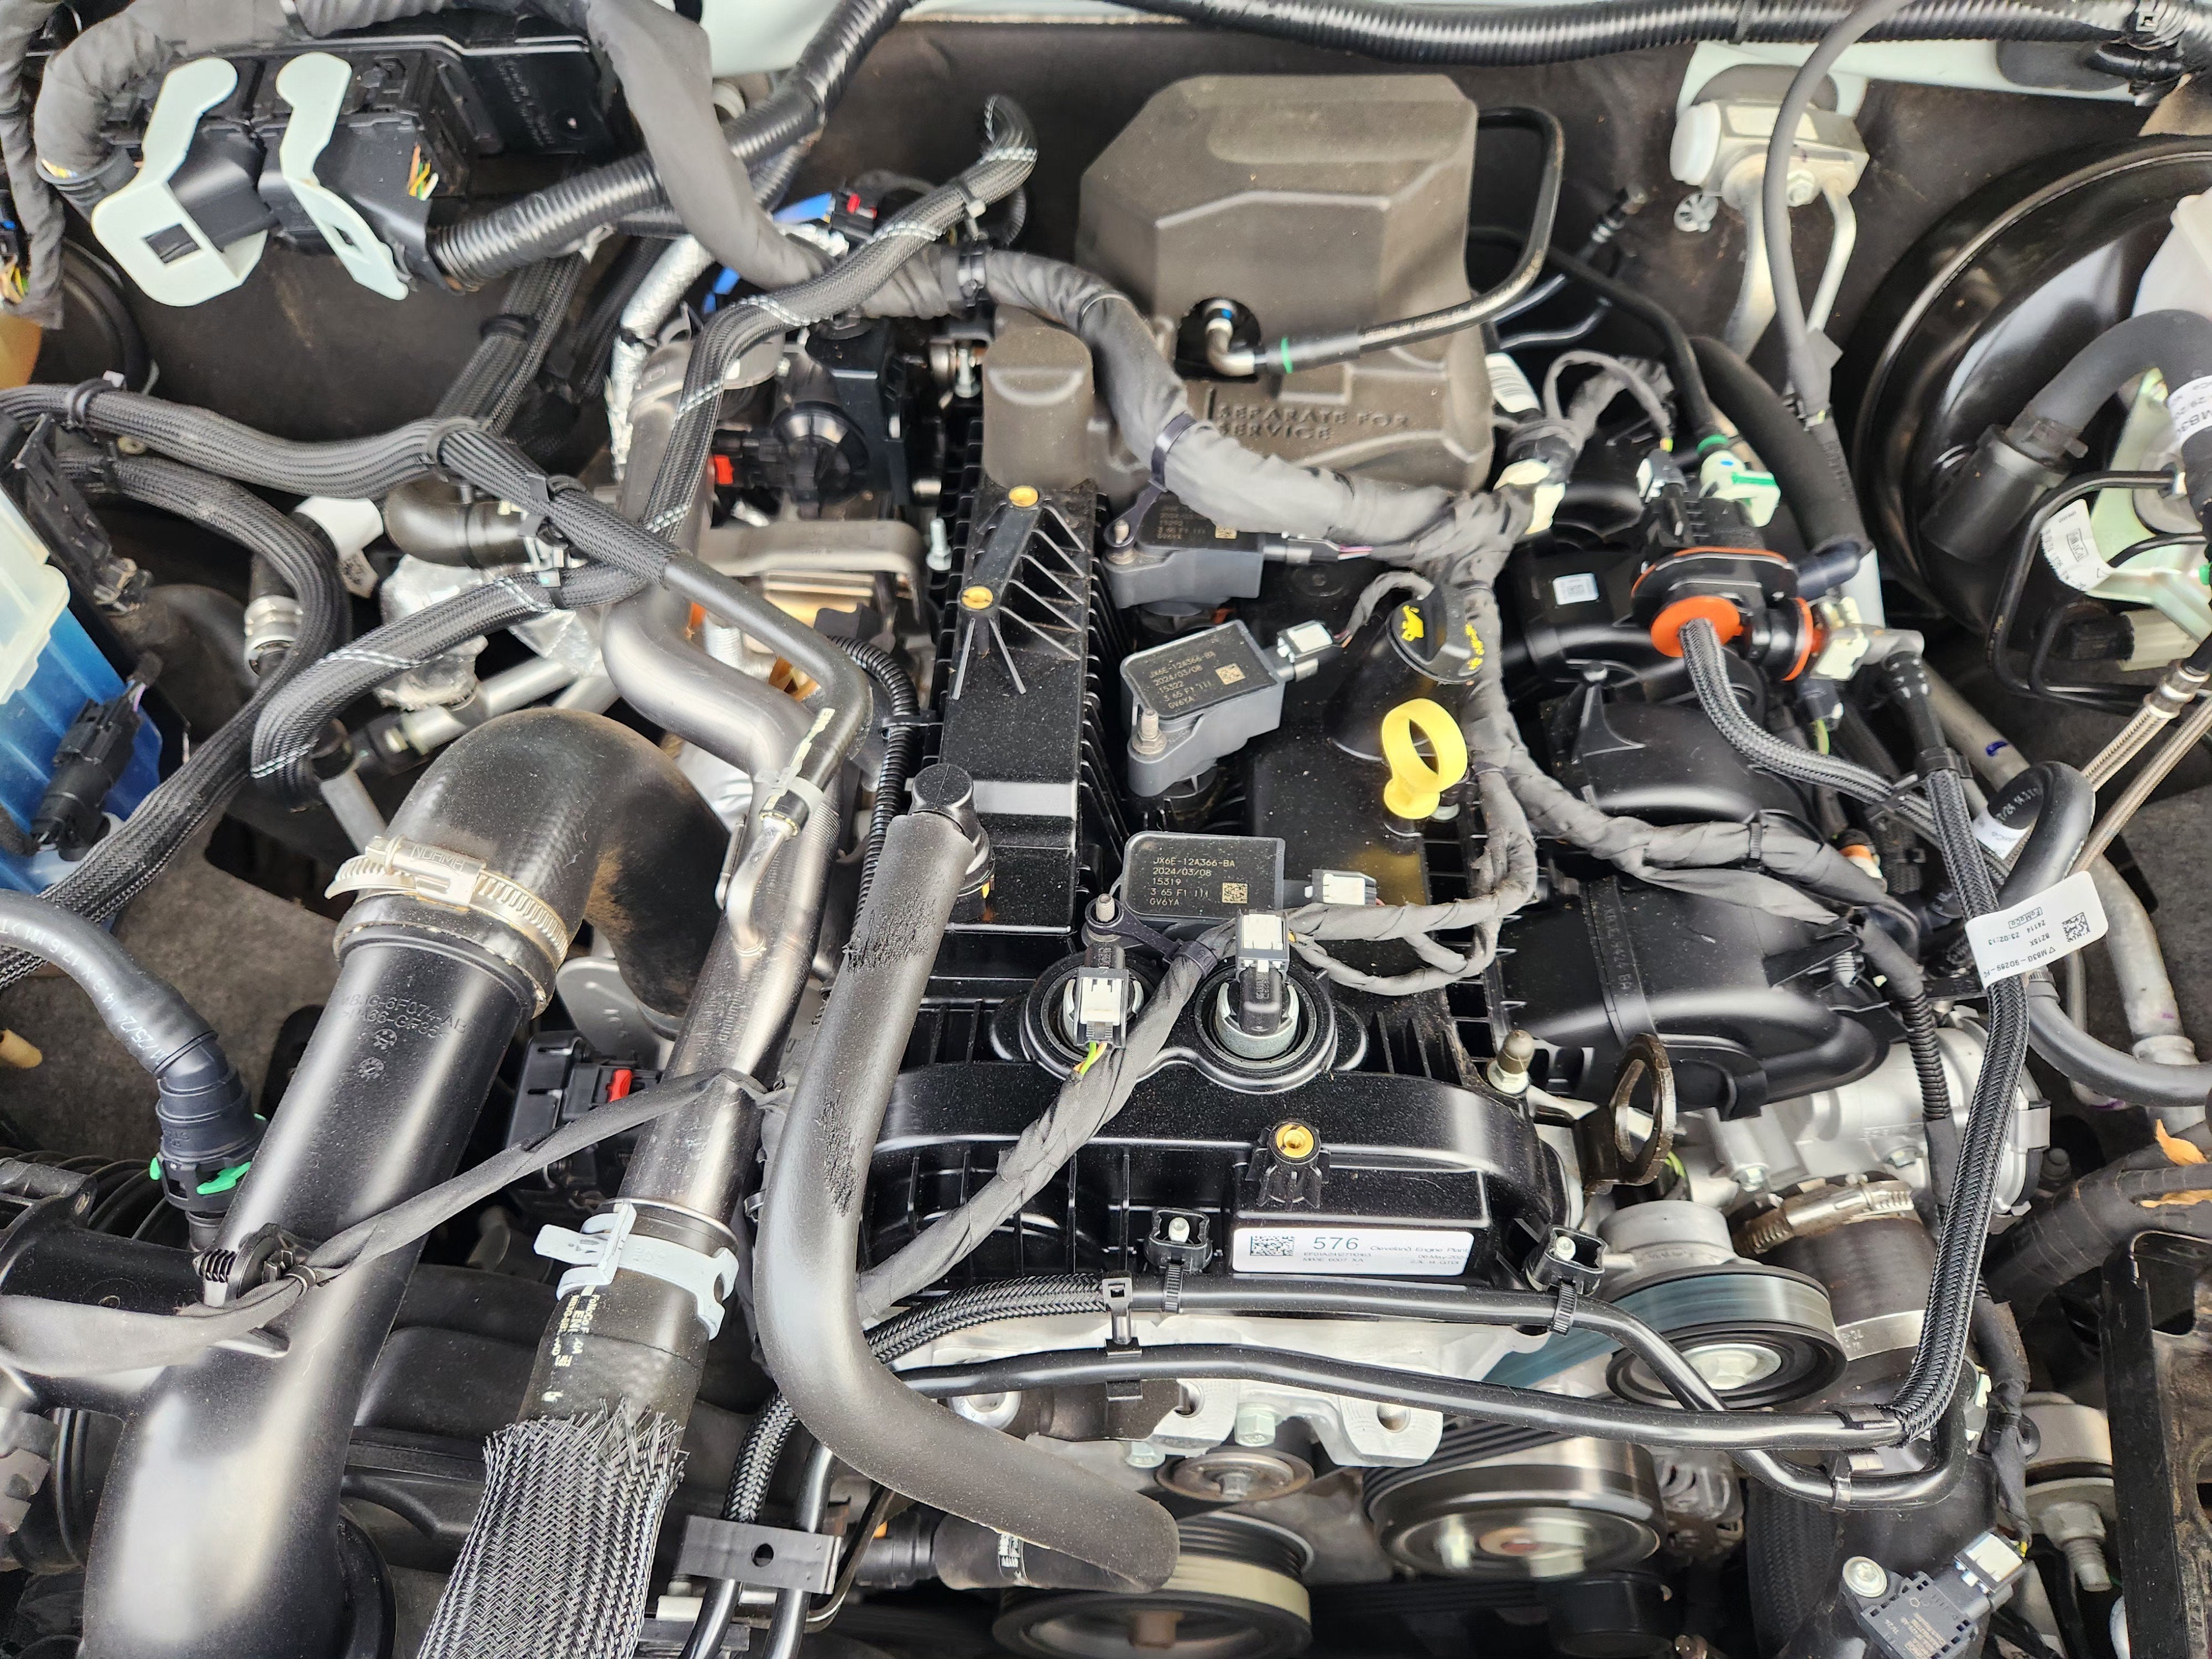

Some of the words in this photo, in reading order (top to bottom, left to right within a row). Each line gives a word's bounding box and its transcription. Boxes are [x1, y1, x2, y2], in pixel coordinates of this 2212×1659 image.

[1358, 411, 1408, 428] FOR
[1153, 665, 1203, 686] 2024/03/08
[1153, 857, 1235, 868] JX6E-12A366-BA
[1152, 867, 1212, 877] 2024/03/08
[1152, 877, 1182, 886] 15319
[1150, 888, 1157, 896] 3
[2011, 909, 2042, 926] FoMoCo
[1313, 1237, 1359, 1250] 576
